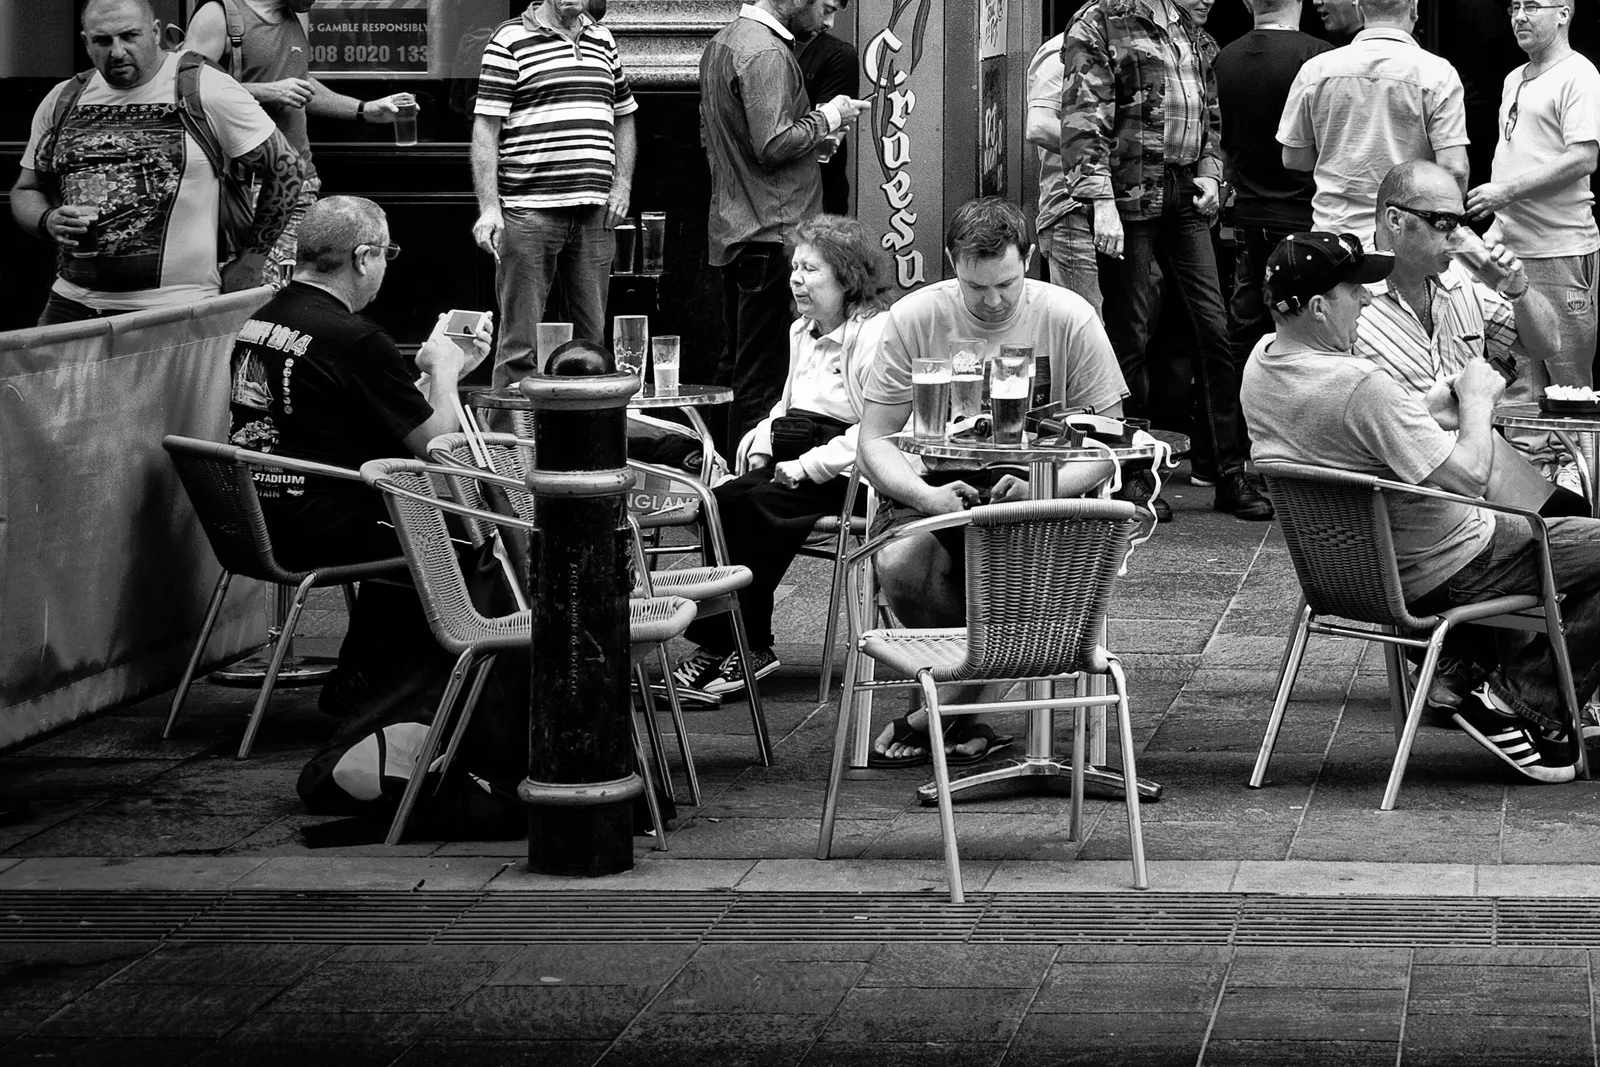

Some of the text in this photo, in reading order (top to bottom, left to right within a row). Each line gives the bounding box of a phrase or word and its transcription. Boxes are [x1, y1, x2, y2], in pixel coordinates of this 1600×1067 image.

[317, 22, 359, 33] GAMBLE
[362, 22, 428, 33] RESPONSIBLY
[344, 45, 391, 63] 8020
[266, 324, 313, 357] 2014
